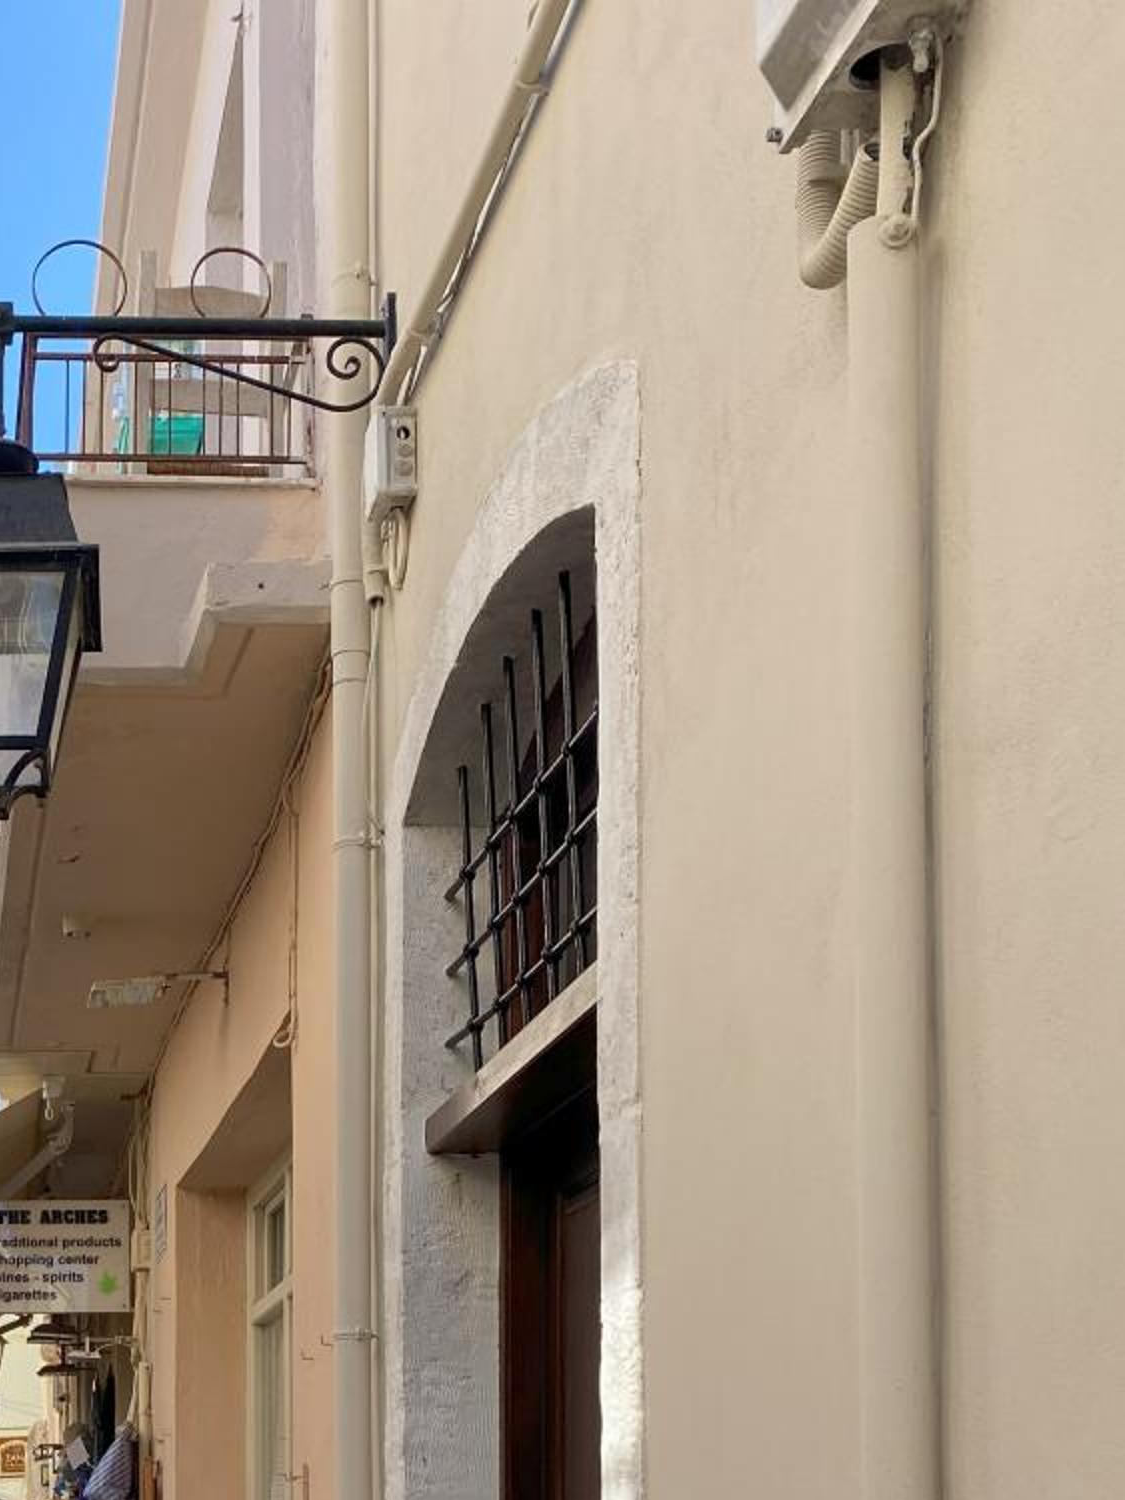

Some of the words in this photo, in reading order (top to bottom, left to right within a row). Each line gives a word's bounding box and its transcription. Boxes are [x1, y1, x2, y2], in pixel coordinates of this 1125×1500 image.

[40, 1209, 109, 1225] ARCHES
[62, 1237, 122, 1249] products
[58, 1254, 99, 1265] center
[42, 1271, 84, 1285] spirits
